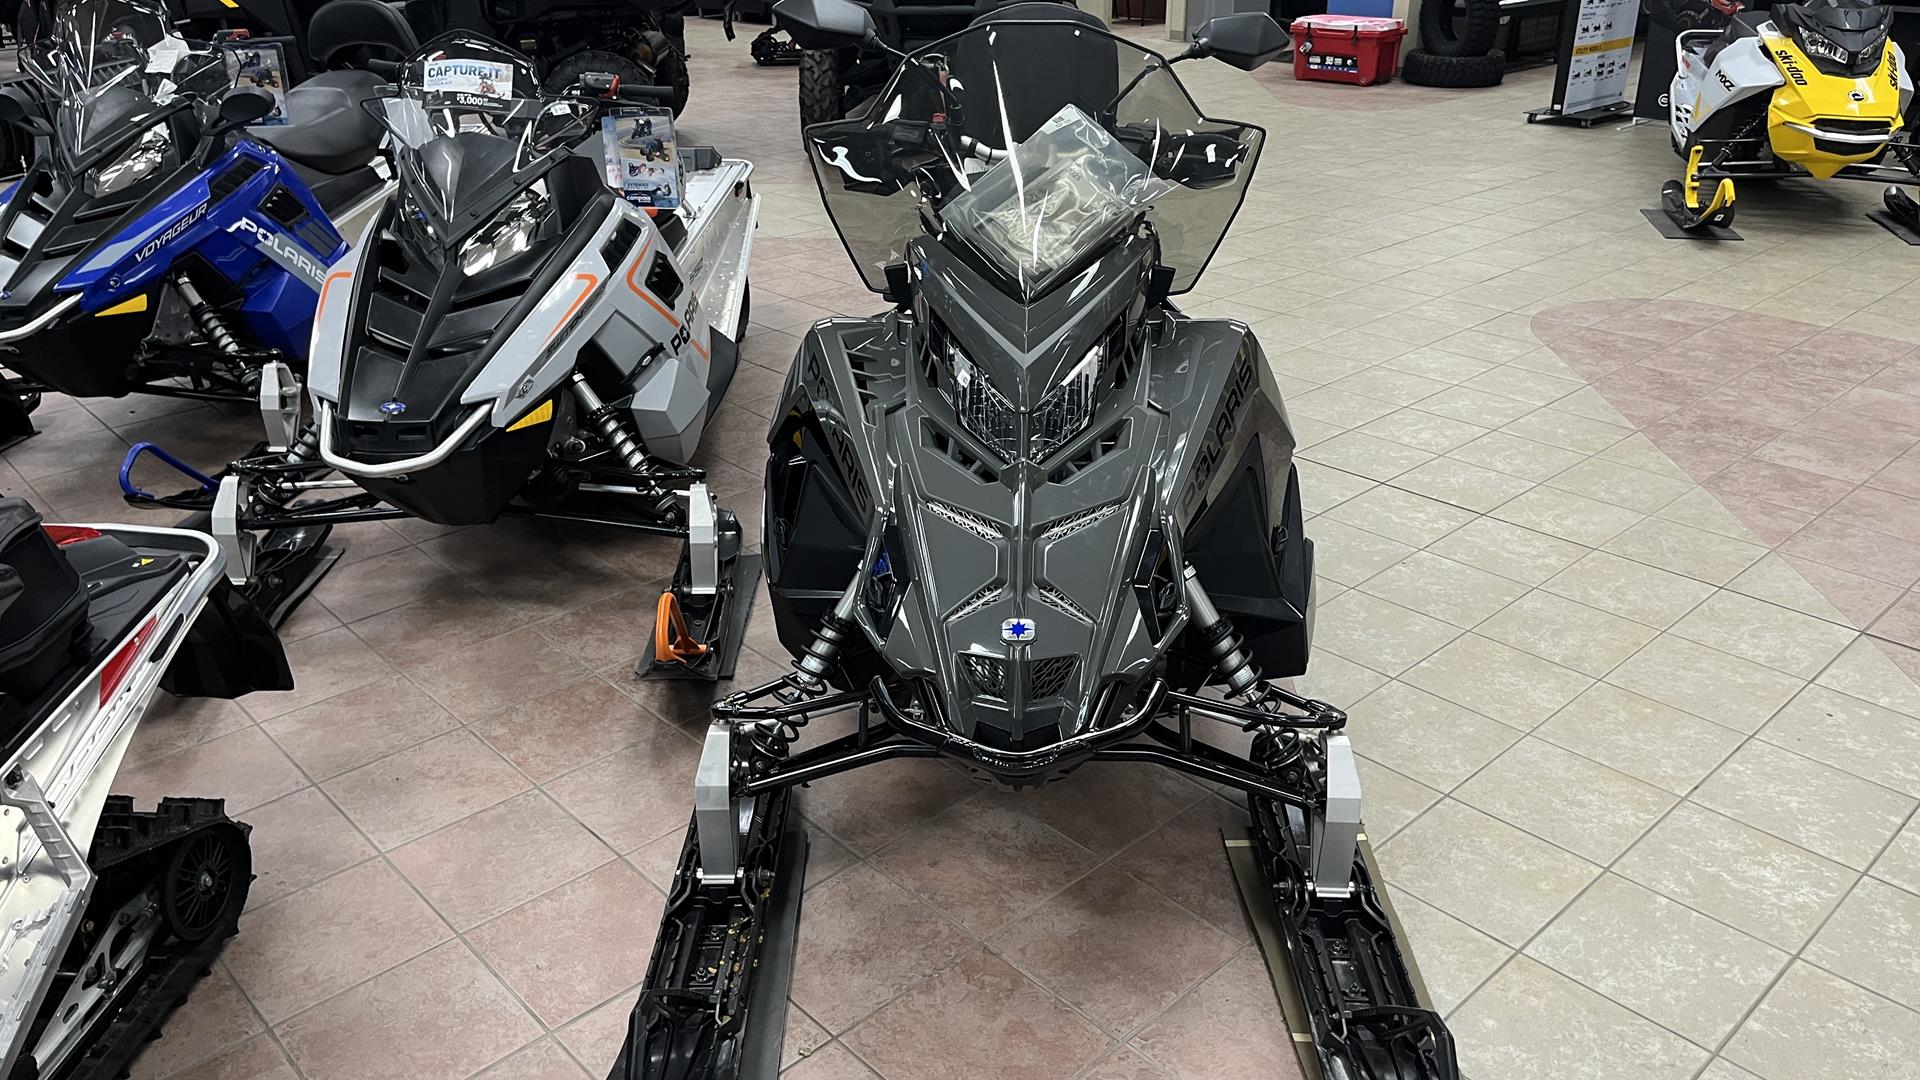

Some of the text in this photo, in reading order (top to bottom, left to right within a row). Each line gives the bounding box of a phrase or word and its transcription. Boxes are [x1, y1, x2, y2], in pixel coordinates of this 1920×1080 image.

[428, 64, 502, 79] CAPTURE IT
[1715, 69, 1736, 92] MXZ
[135, 202, 208, 263] VOYAGEUR
[239, 216, 327, 284] POLARIS
[808, 351, 869, 515] POARIS
[1183, 356, 1252, 520] POLARIS
